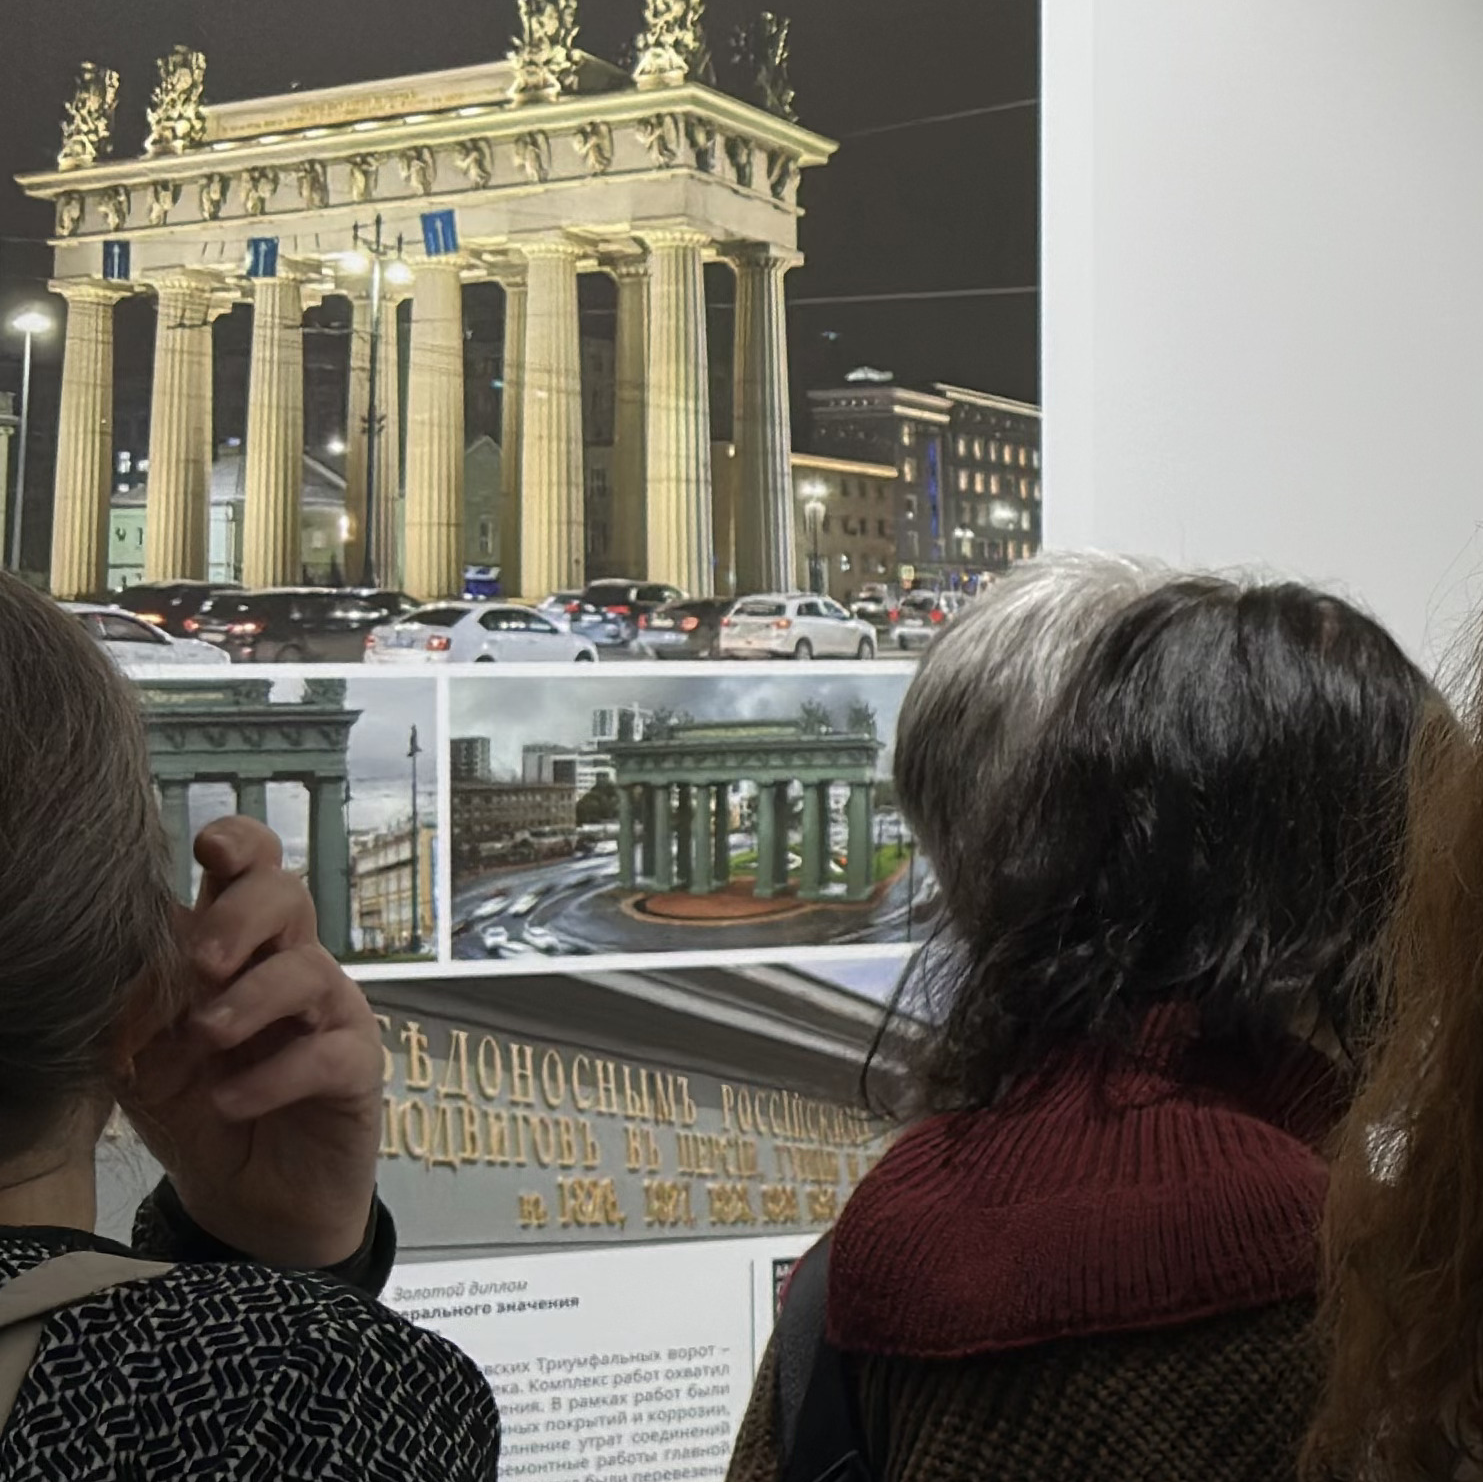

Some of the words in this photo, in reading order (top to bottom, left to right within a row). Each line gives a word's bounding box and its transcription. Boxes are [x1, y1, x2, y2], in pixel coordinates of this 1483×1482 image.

[401, 1303, 492, 1324] ерального
[483, 1361, 530, 1376] вских
[499, 1402, 540, 1416] ения.
